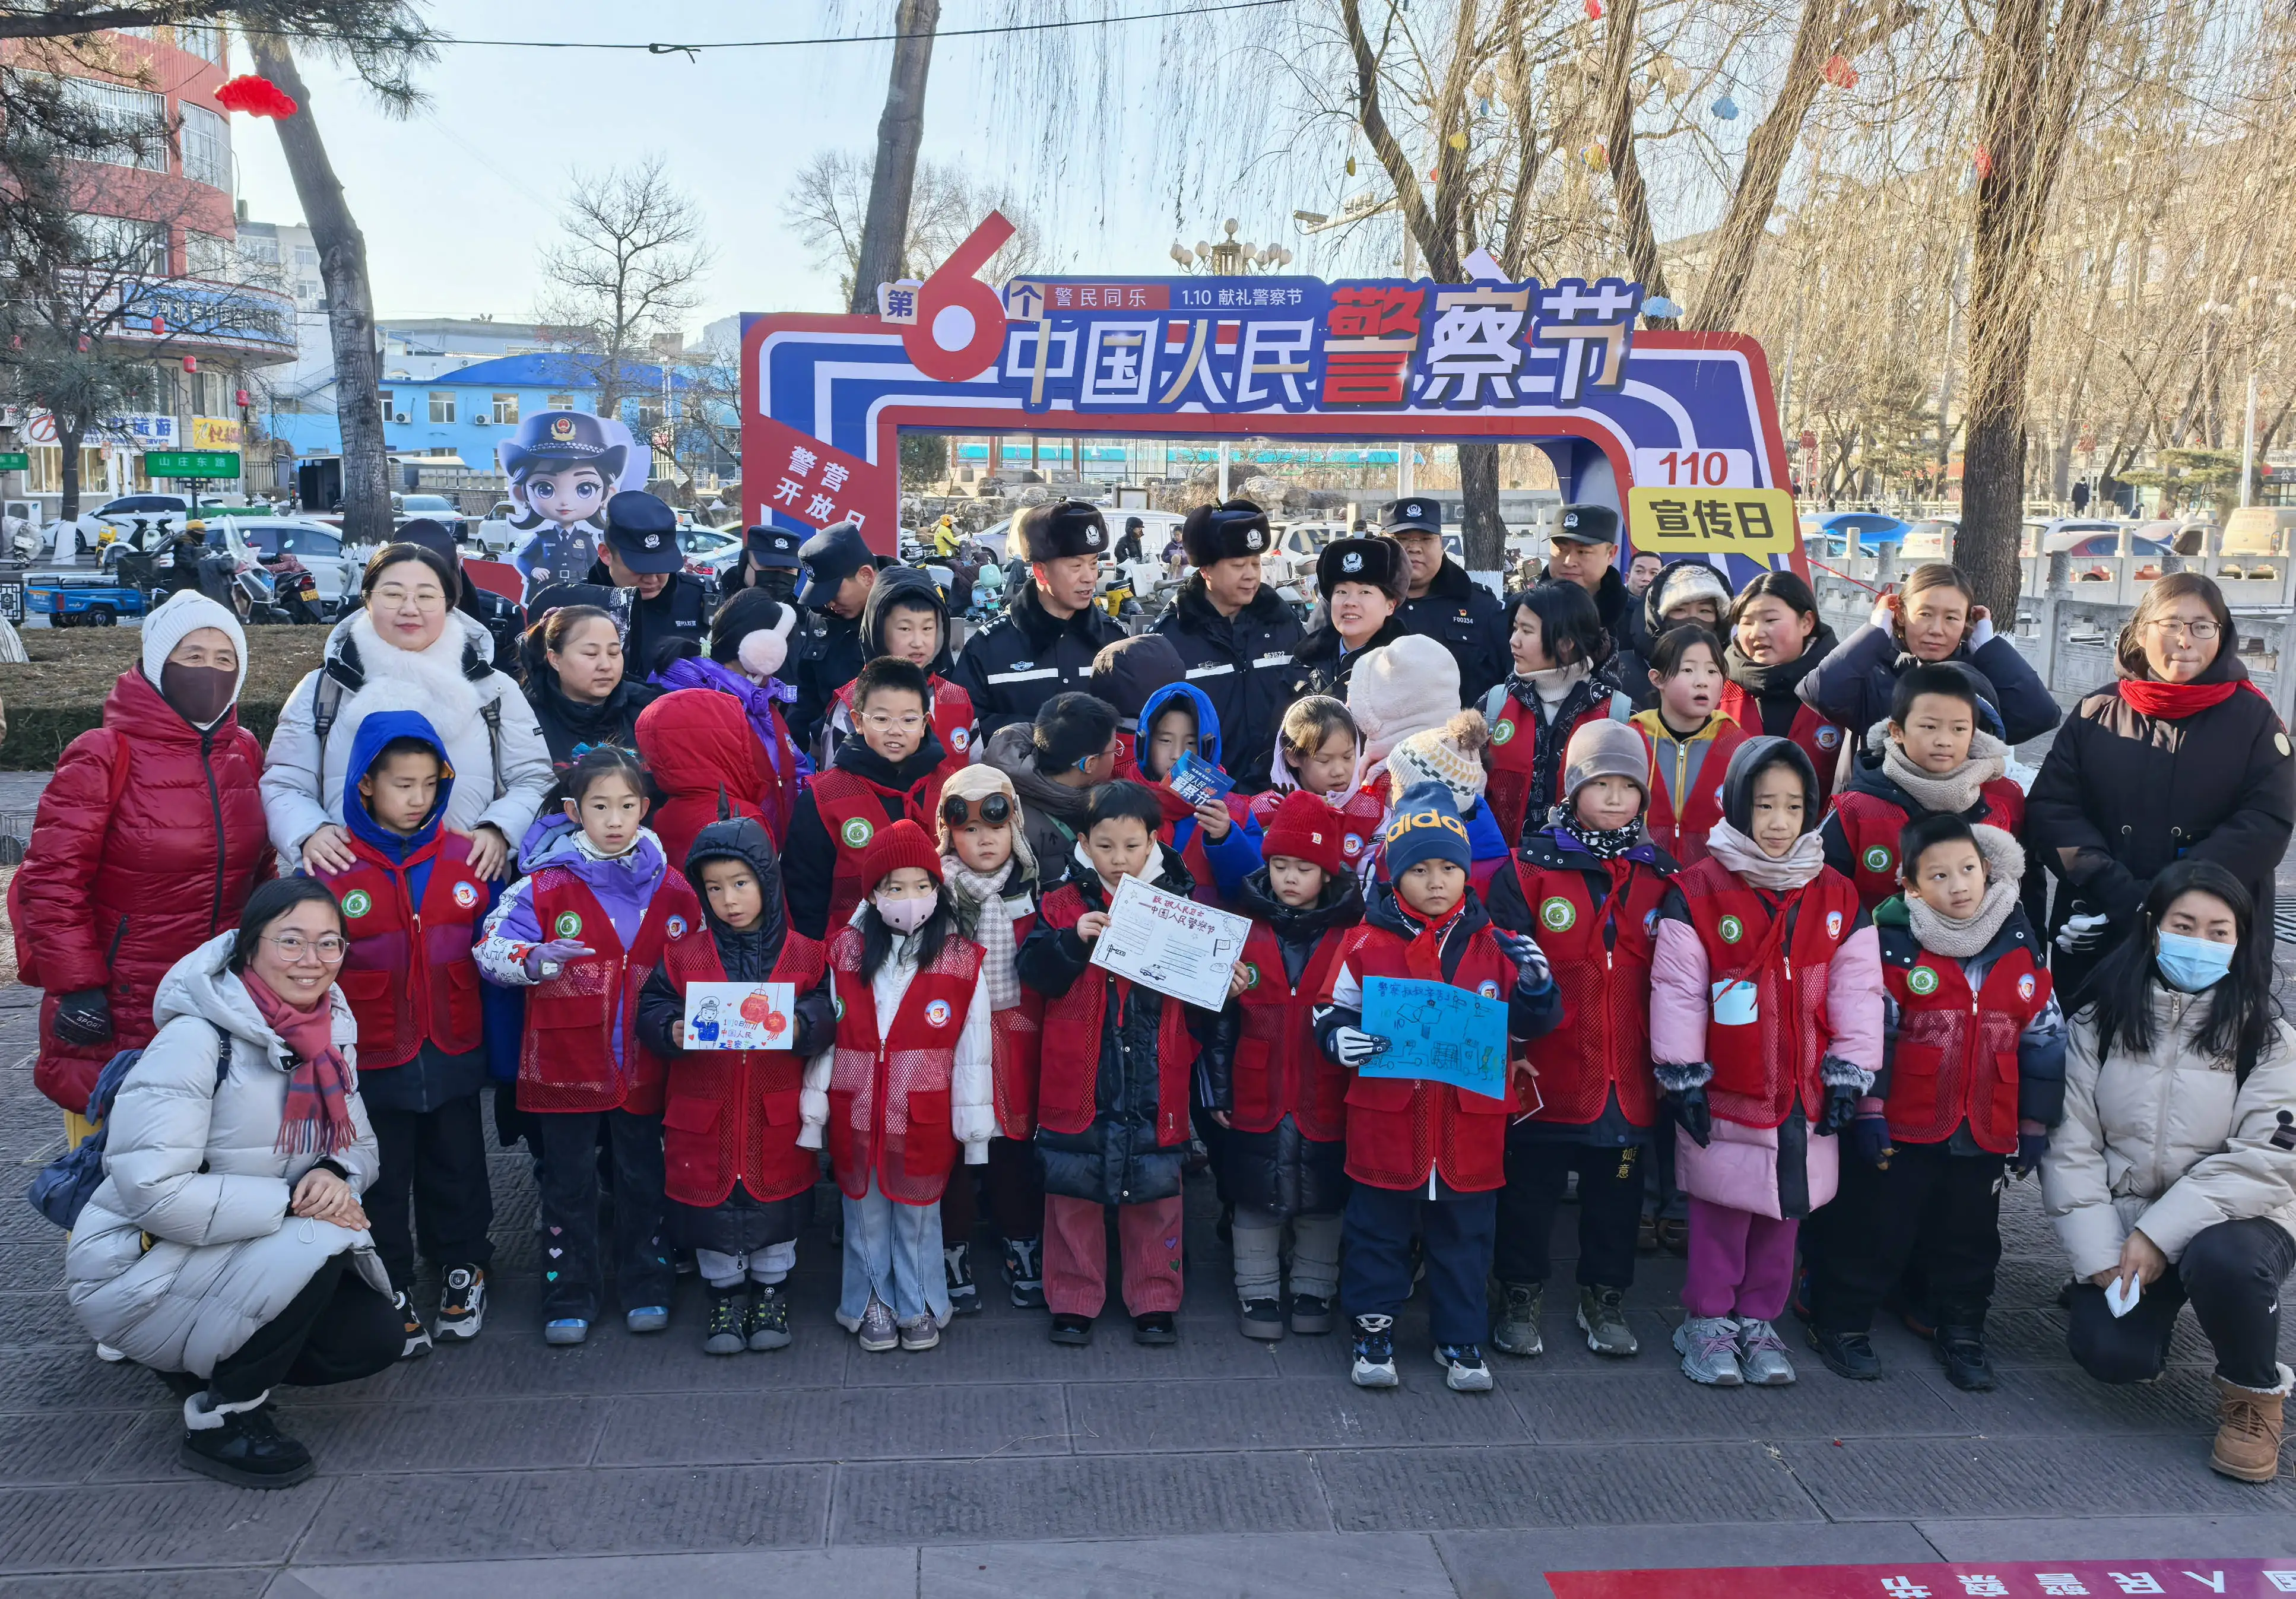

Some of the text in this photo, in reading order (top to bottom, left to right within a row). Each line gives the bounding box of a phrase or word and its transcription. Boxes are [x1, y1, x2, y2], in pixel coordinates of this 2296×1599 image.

[1055, 287, 1146, 307] 警民同乐
[1182, 288, 1304, 306] 1.10 献礼警察节
[1005, 285, 1634, 404] 中国人民警察节
[159, 456, 226, 467] 山庄东路
[788, 446, 850, 493] 警营
[1658, 451, 1729, 486] 110
[773, 477, 867, 531] 开放日
[1649, 500, 1775, 540] 宣传日
[721, 1027, 753, 1039] 中国人民
